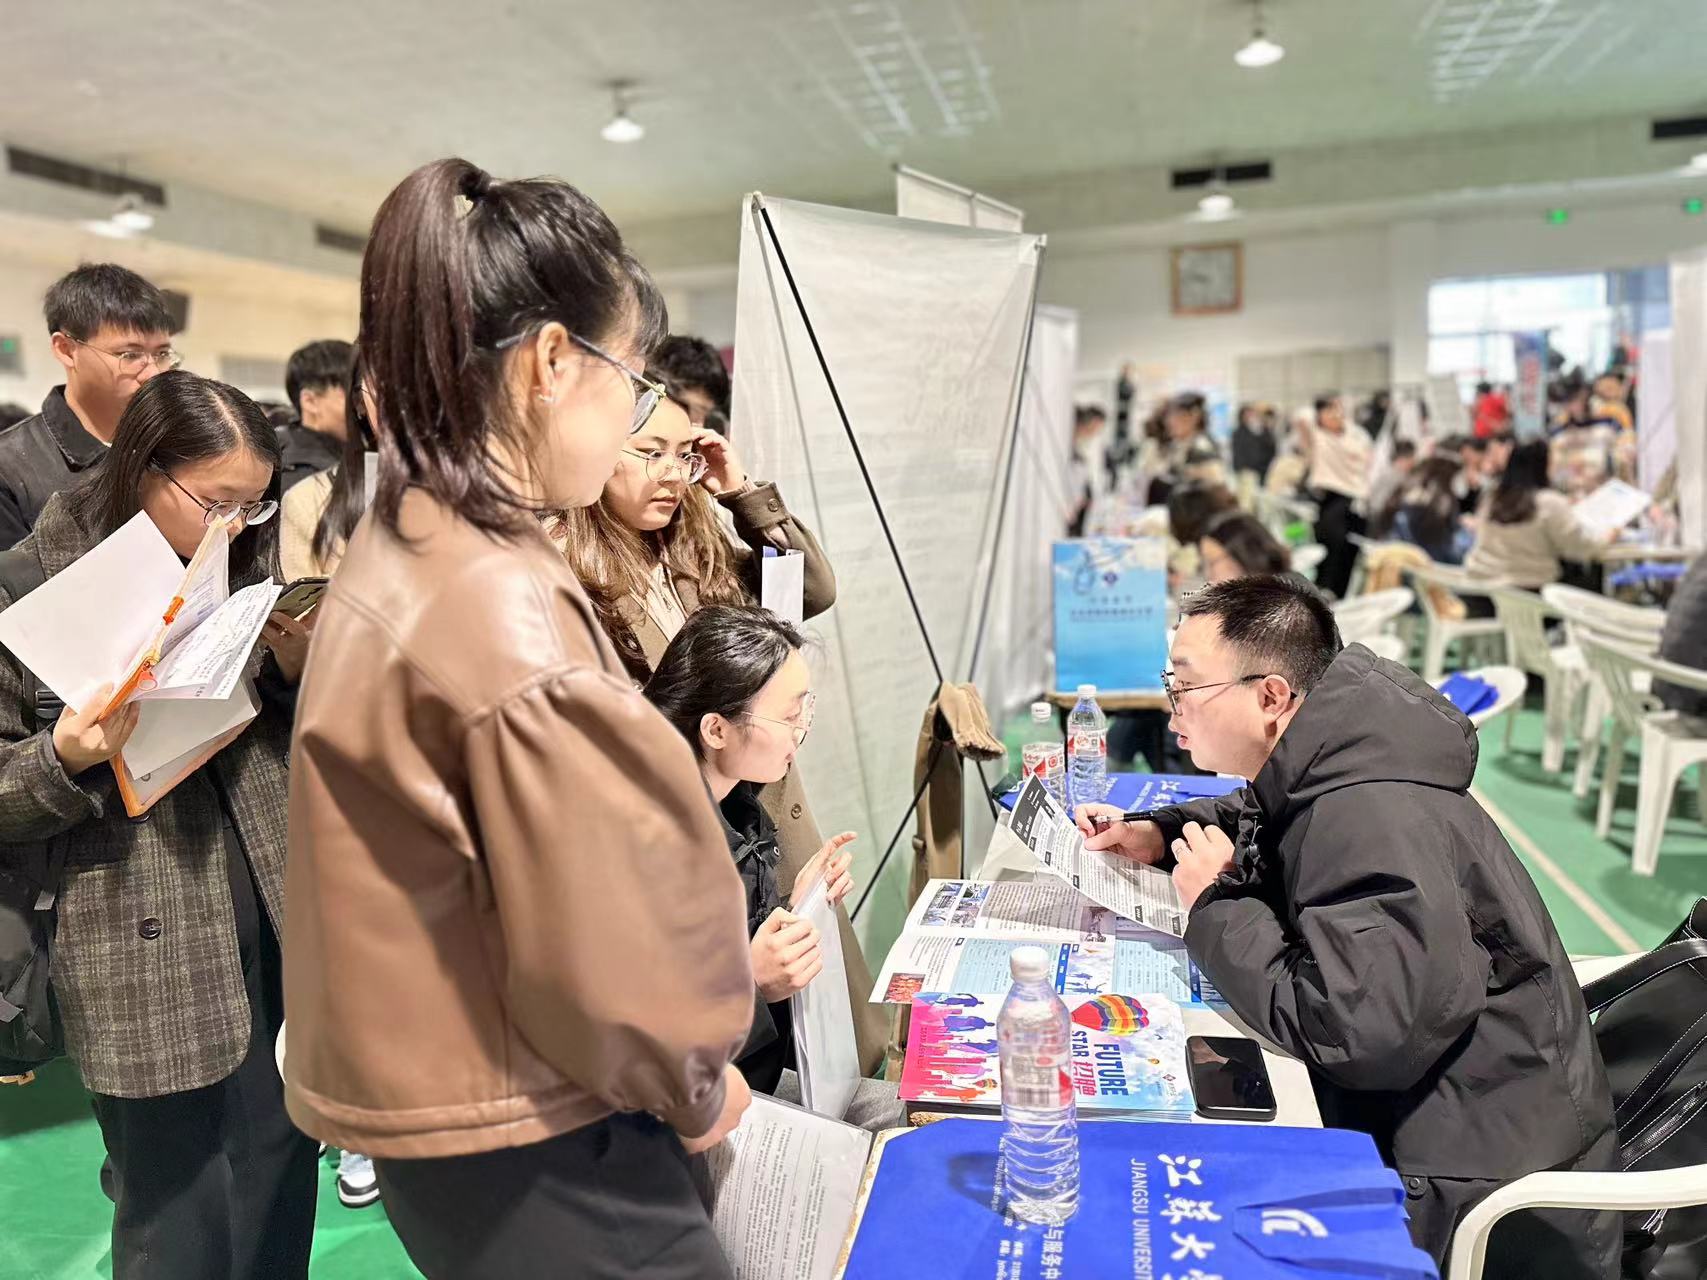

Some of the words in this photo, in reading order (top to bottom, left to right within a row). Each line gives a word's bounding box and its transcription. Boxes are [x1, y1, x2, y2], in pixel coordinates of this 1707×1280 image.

[1071, 1030, 1090, 1058] STAR
[1093, 1043, 1129, 1096] FUTURE
[1131, 1157, 1149, 1214] JIANGSU
